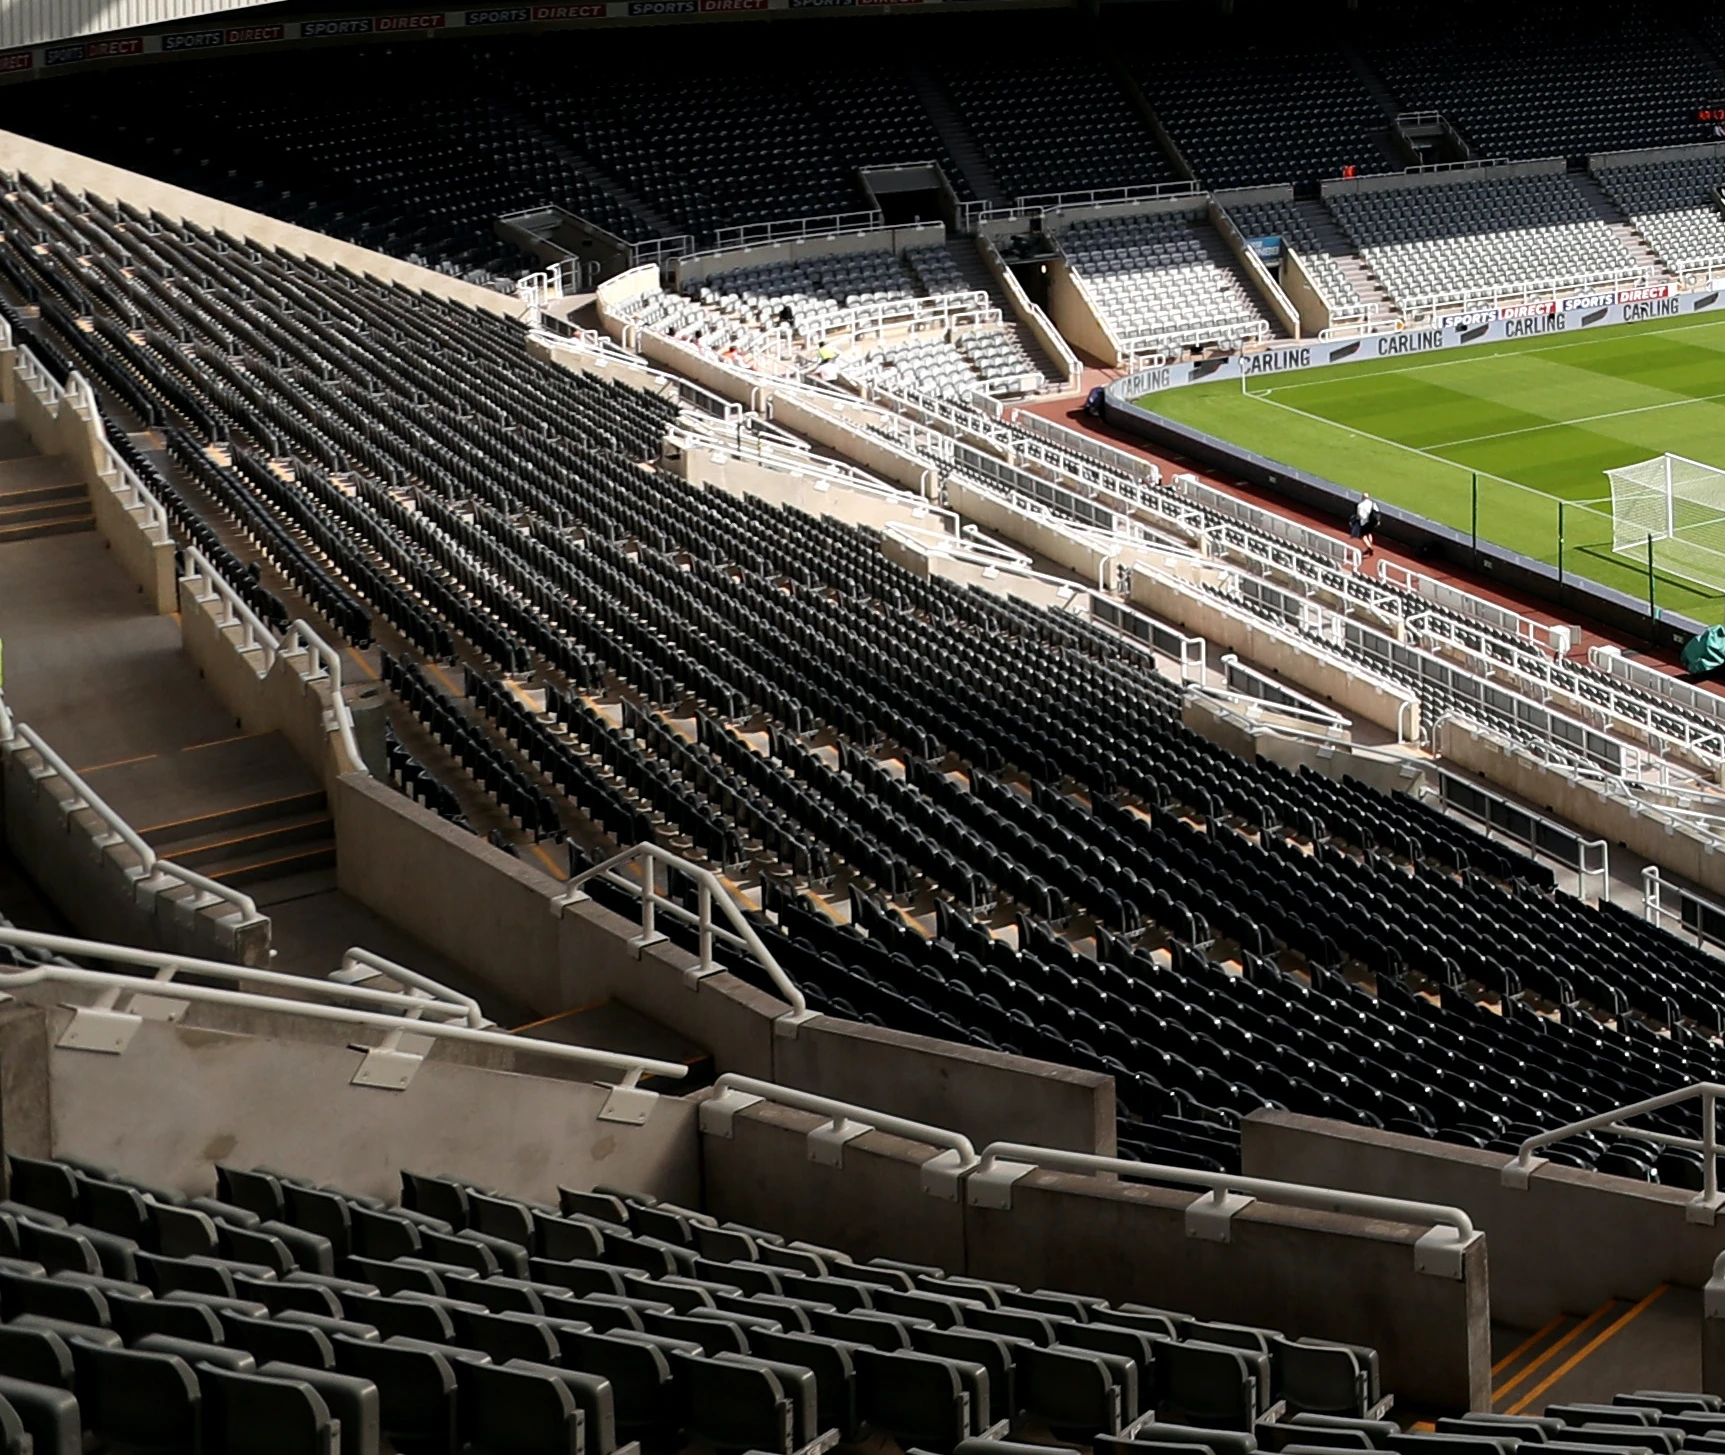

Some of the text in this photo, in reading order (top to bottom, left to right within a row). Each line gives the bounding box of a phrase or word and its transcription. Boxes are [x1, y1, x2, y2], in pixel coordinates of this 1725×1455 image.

[469, 5, 602, 24] SPORTS DIRECT
[632, 1, 695, 14] SPORTS
[304, 15, 441, 35] SPORTS DIRECT
[165, 27, 281, 49] SPORTS DIRECT
[1565, 286, 1669, 311] SPORTS DIRECT
[1623, 298, 1679, 321] CARLING
[1444, 302, 1555, 328] SPORTS DIRECT
[1505, 313, 1565, 337] CARLING
[1378, 330, 1442, 355] CARLING
[1242, 348, 1310, 375] CARLING
